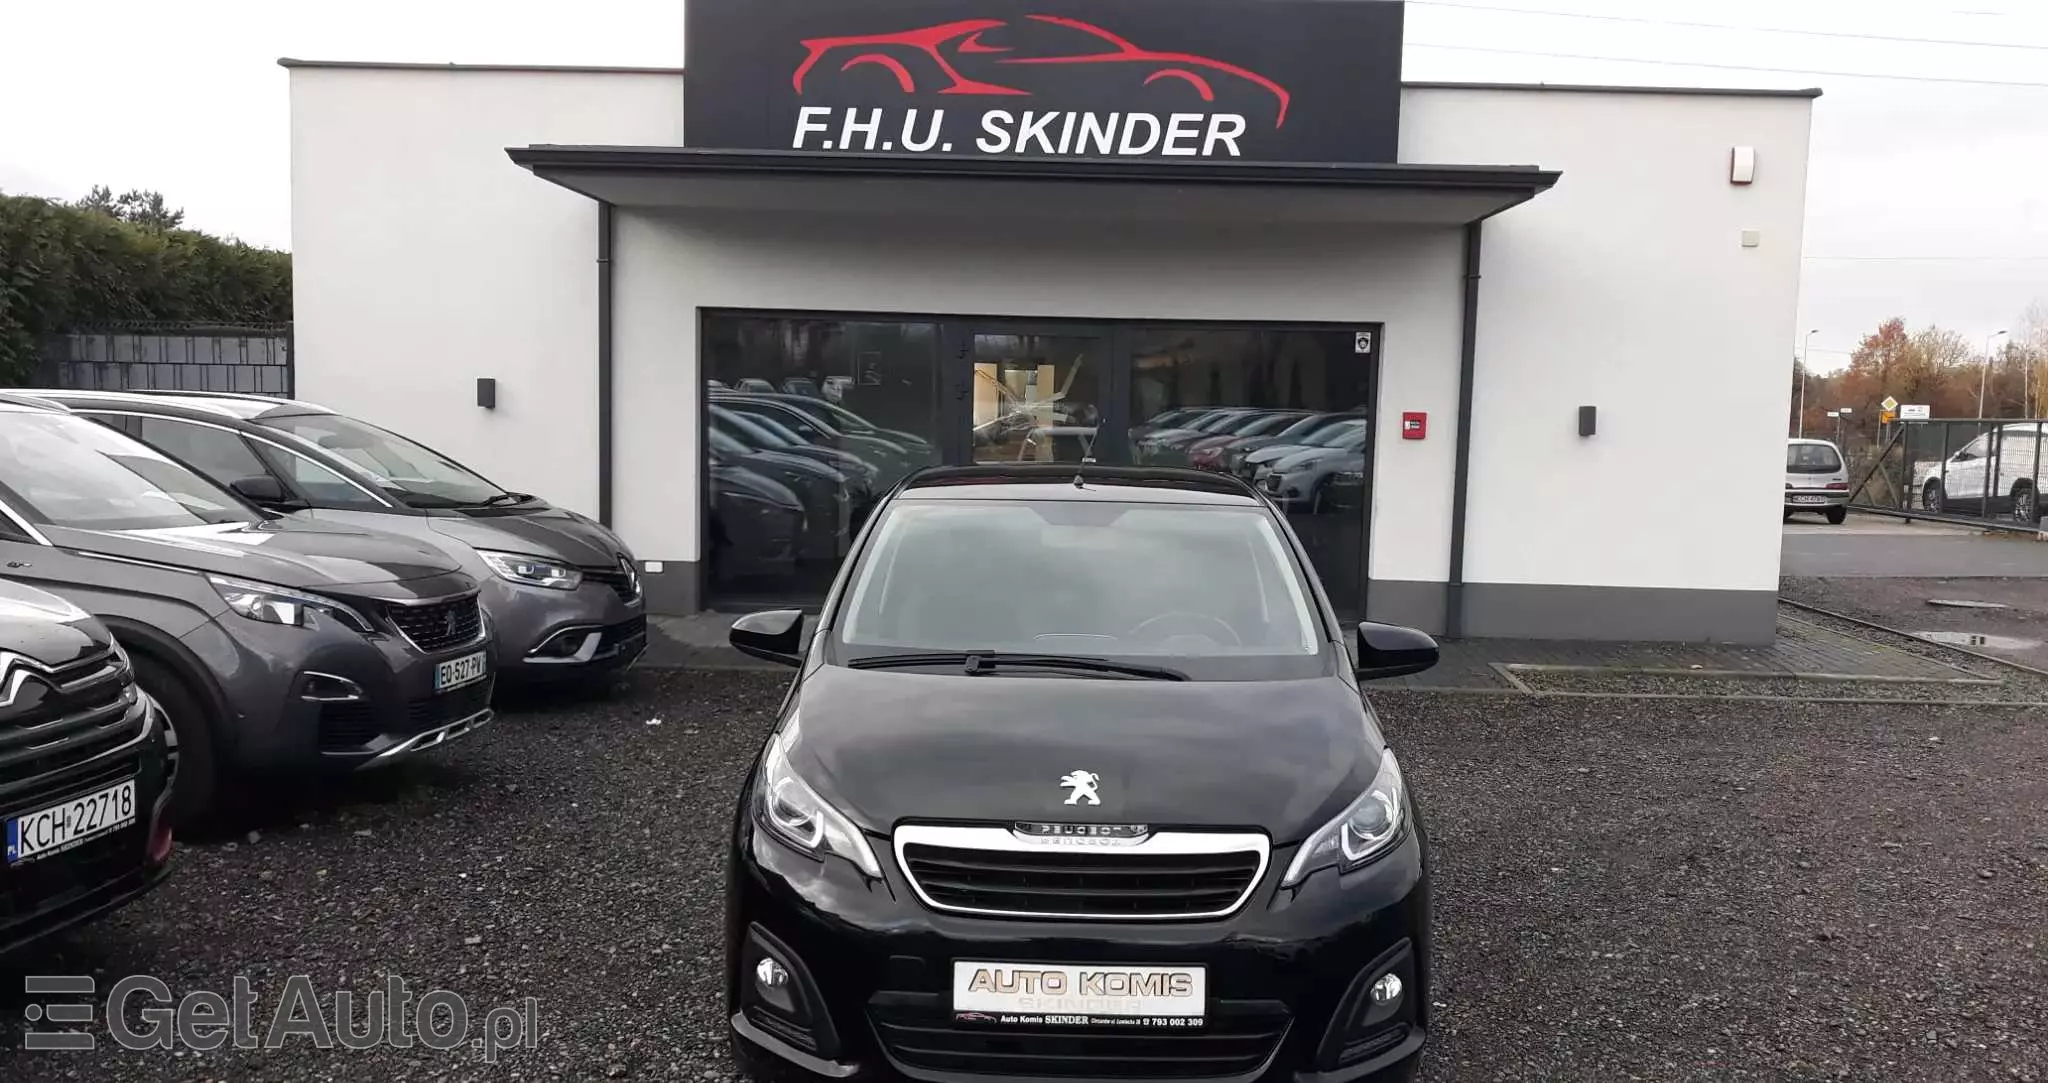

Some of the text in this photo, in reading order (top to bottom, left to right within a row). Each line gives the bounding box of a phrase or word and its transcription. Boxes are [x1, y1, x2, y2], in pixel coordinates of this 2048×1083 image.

[793, 107, 1246, 157] F.H.U. SKINDER
[20, 808, 65, 854] KCH
[73, 785, 132, 836] 22718
[968, 968, 1193, 998] AUTO KOMIS
[1001, 1015, 1018, 1023] Auto
[1020, 1015, 1043, 1024] Komis
[1045, 1015, 1089, 1025] SKINDER
[1152, 1017, 1168, 1026] 793
[1169, 1018, 1185, 1026] 002
